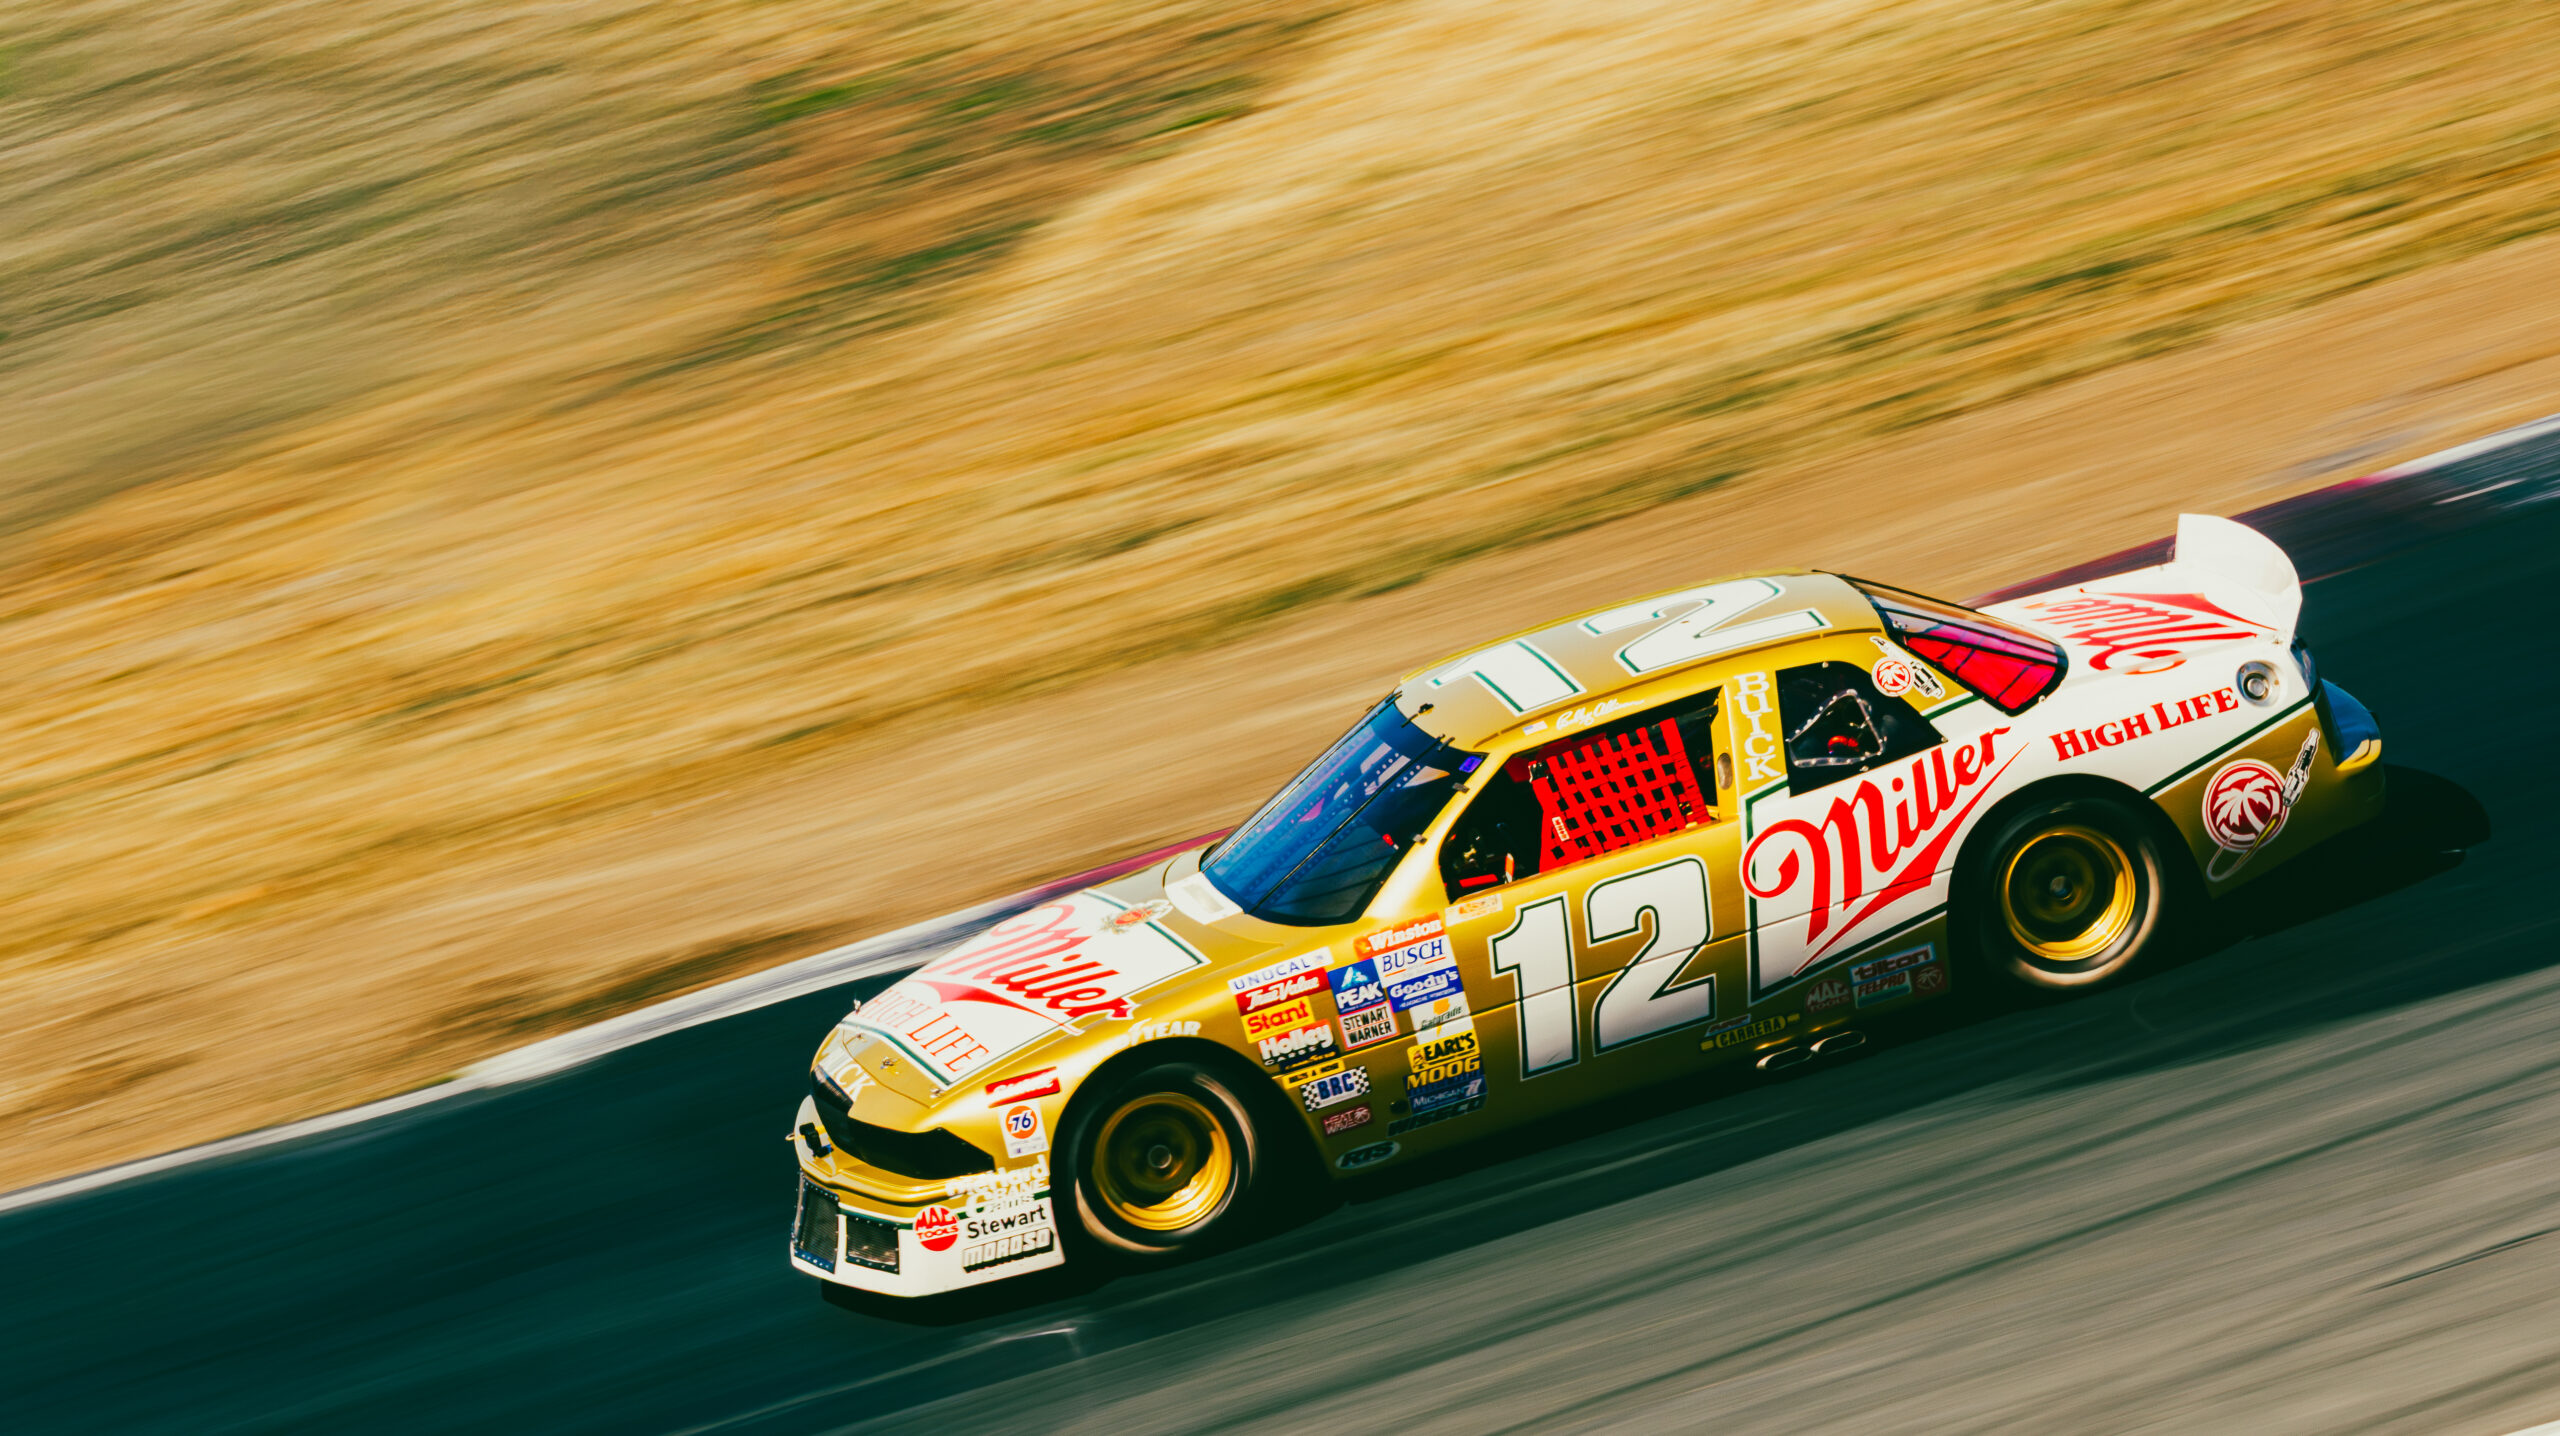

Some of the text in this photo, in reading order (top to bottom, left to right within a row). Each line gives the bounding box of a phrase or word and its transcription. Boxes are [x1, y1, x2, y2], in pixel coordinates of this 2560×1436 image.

[1427, 577, 1832, 716] 12
[1733, 671, 1782, 781] BUICK
[2049, 686, 2240, 762] HIGH LIFE
[1742, 726, 2012, 948] Miller
[1368, 919, 1443, 951] Winston
[923, 904, 1134, 1020] Miller
[1383, 939, 1444, 973] BUSCH
[1488, 854, 1717, 1082] 12
[1234, 958, 1311, 990] UNOCAL
[1390, 968, 1459, 1000] Goody's
[1336, 981, 1384, 1009] PEAK
[1247, 1000, 1309, 1035] Stant
[1343, 1006, 1389, 1031] STEWART
[1348, 1021, 1392, 1045] WARNER
[1720, 1019, 1782, 1046] CARRERA
[906, 1012, 990, 1072] LIFE
[1259, 1024, 1334, 1060] Holley
[1424, 1032, 1476, 1062] EARL'S
[1407, 1055, 1481, 1091] MOOG
[1010, 1110, 1032, 1132] 76
[915, 1207, 956, 1231] MAC
[917, 1225, 959, 1240] TOOLS
[967, 1204, 1047, 1239] Stewart
[963, 1227, 1054, 1273] MOROSO
